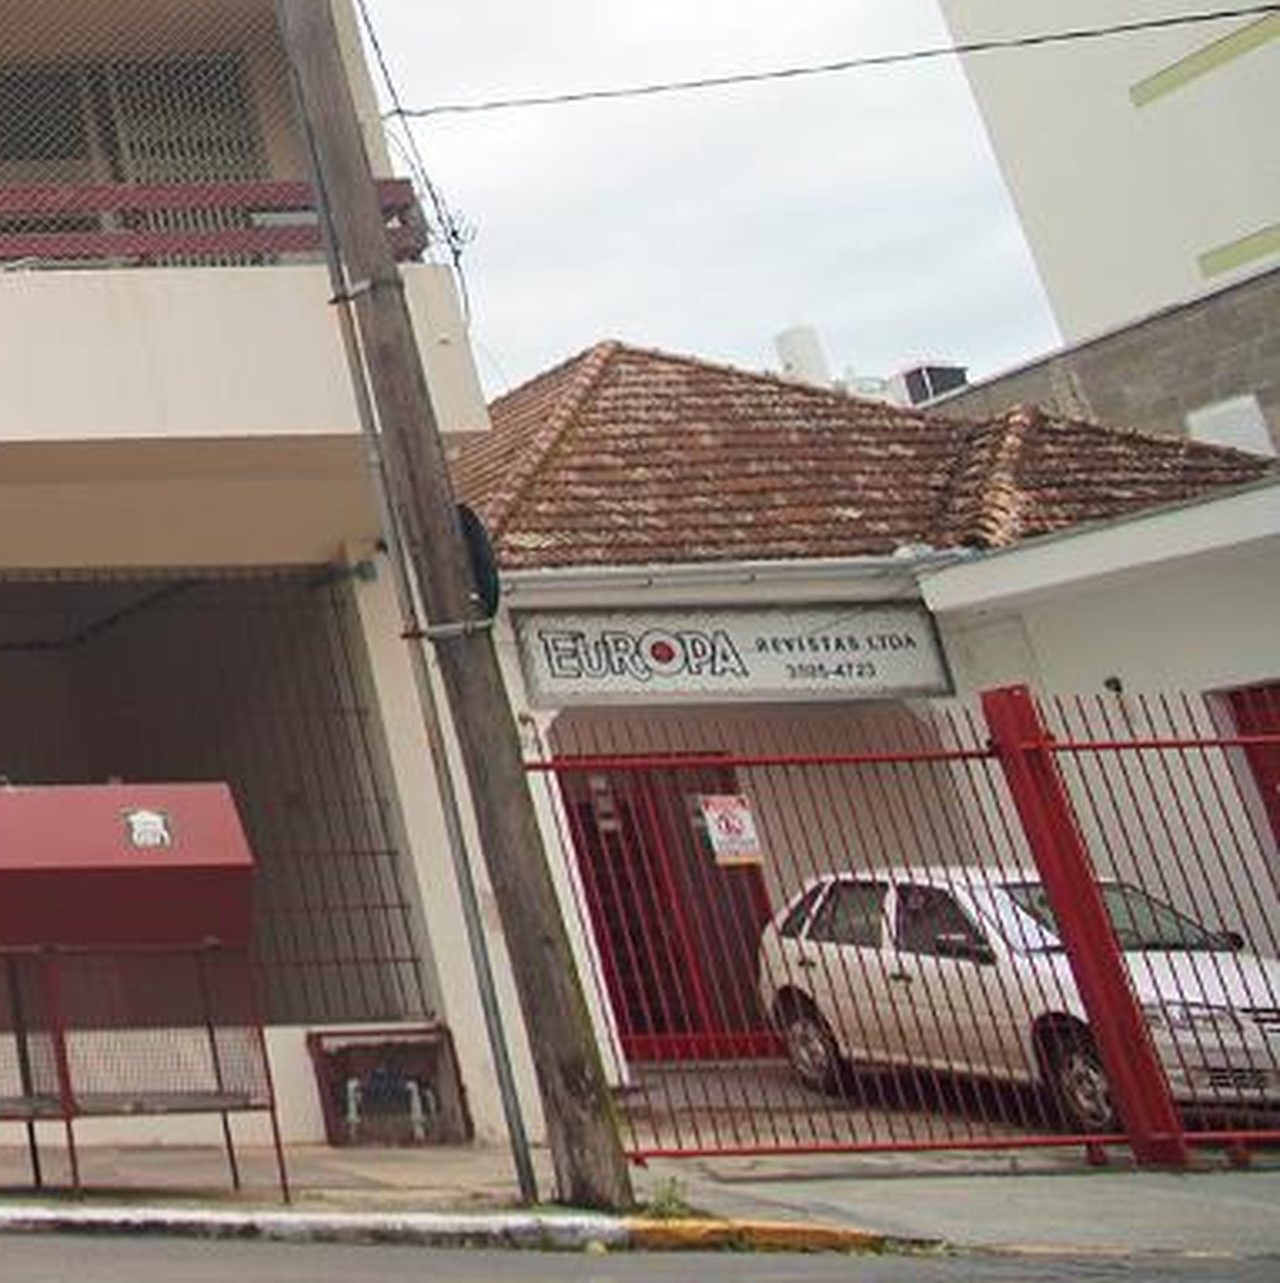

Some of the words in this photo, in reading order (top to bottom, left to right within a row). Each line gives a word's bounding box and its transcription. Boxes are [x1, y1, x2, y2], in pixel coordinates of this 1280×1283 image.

[538, 628, 750, 682] EUROPA
[755, 635, 860, 654] REVISTAS
[865, 632, 917, 651] LTDA
